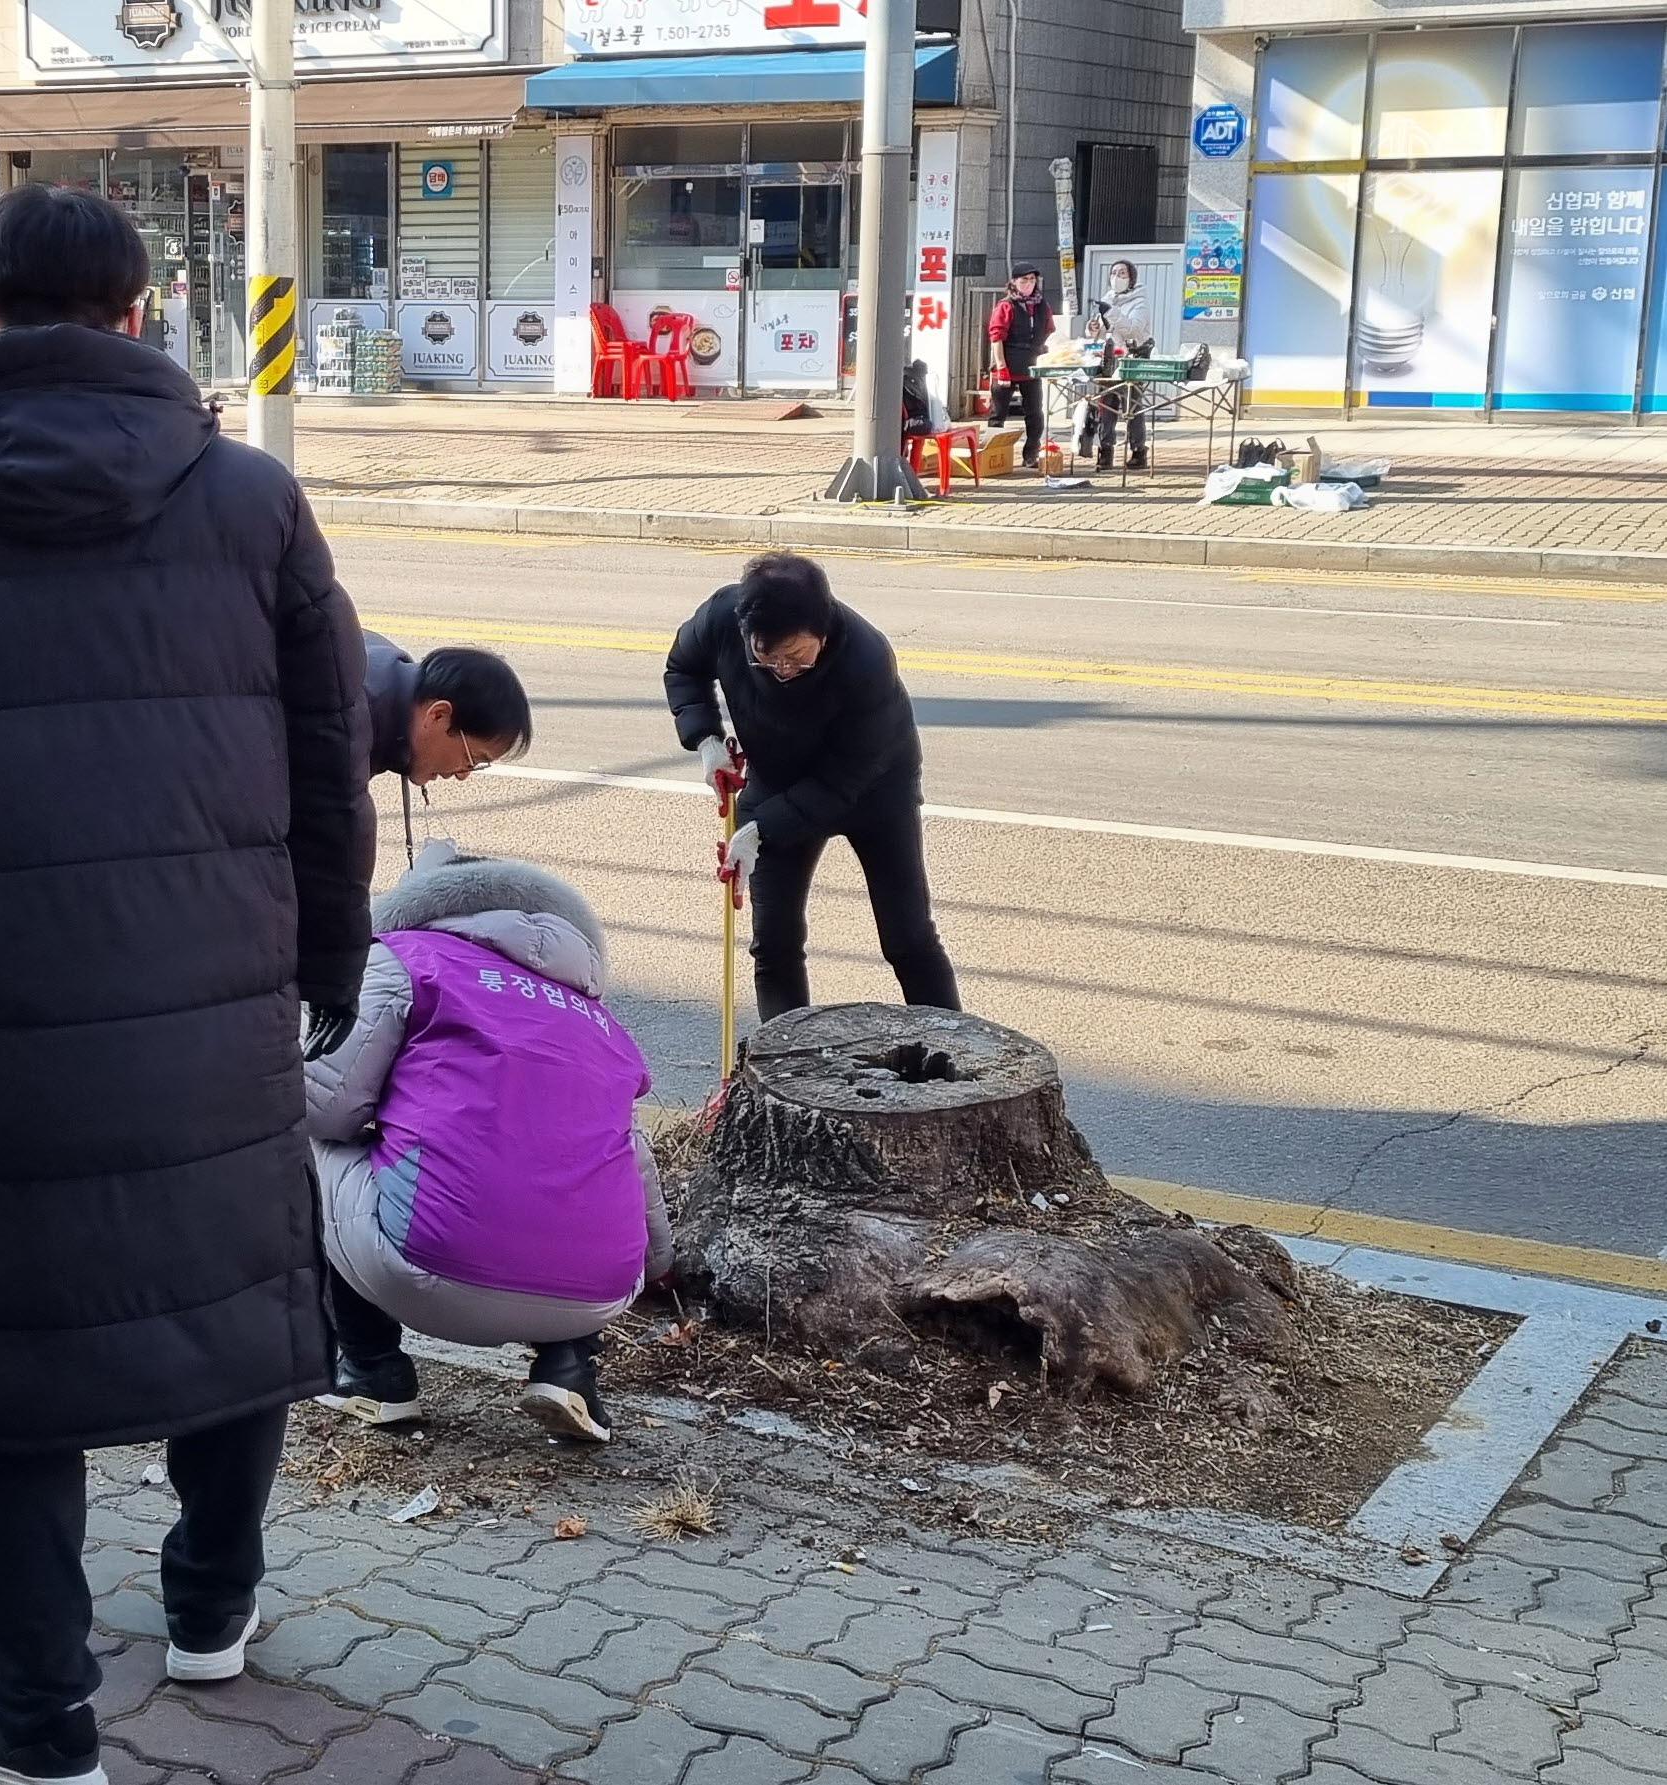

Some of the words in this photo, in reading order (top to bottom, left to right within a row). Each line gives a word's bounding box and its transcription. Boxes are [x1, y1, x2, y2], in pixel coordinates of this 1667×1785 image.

[311, 21, 332, 33] ICE
[334, 19, 381, 32] CREAM
[580, 24, 645, 46] 기절초풍
[656, 24, 731, 41] T.501-2735
[1201, 121, 1238, 141] ADT
[1546, 191, 1603, 211] 신협과
[1607, 189, 1646, 209] 함께
[1511, 216, 1565, 237] 내일을
[1570, 215, 1646, 236] 밝힙니다
[917, 246, 948, 331] 포차
[1610, 287, 1636, 300] 신협
[780, 332, 816, 351] 포차
[412, 352, 464, 365] JUAKING
